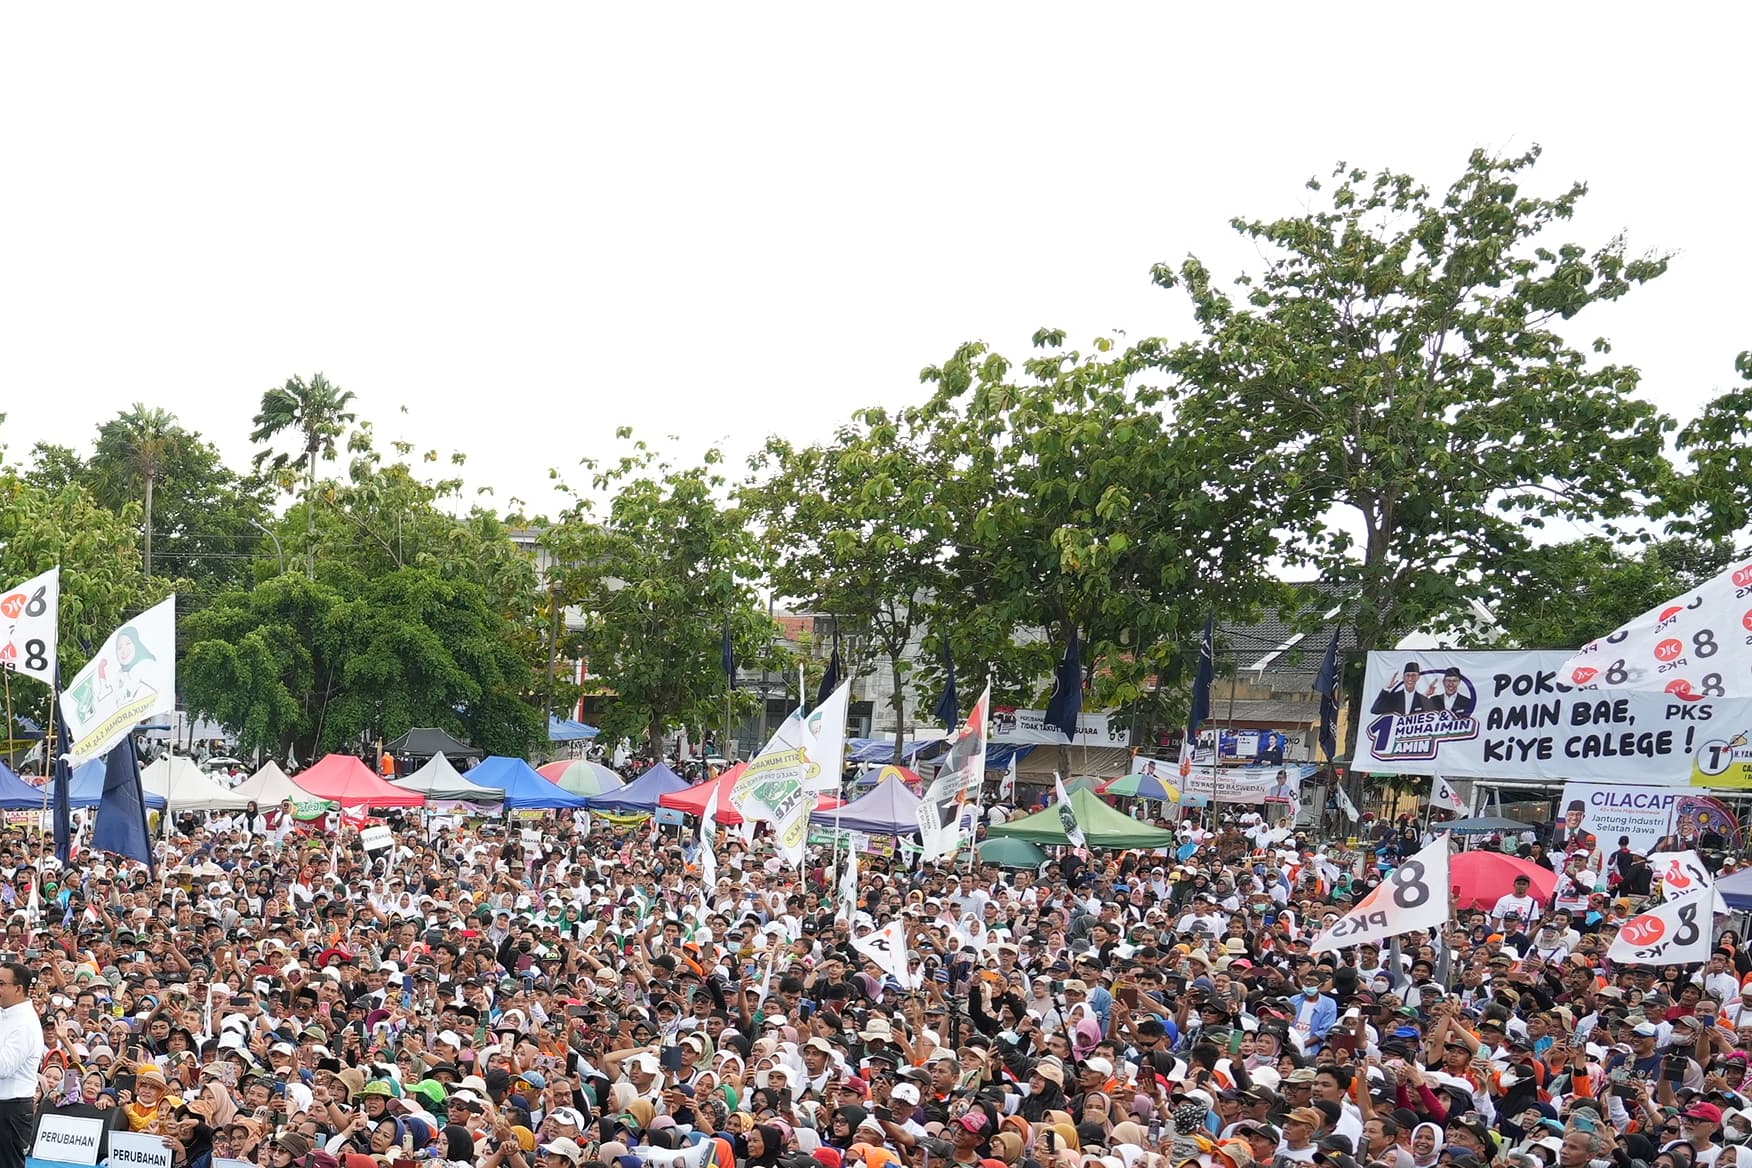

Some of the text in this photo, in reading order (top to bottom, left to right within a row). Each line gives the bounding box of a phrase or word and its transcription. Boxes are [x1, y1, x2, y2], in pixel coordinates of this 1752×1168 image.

[25, 639, 48, 671] 8
[1398, 711, 1448, 725] ANIES &
[1487, 699, 1635, 730] AMIN BAE,
[1665, 704, 1712, 720] PKS
[1370, 715, 1394, 750] 1
[1396, 719, 1470, 735] MUHAIMIN
[1395, 741, 1430, 753] AMIN
[1565, 730, 1672, 758] CALEGE
[1684, 726, 1695, 754] !
[1289, 789, 1298, 801] 8
[1591, 791, 1674, 809] CILACAP
[1592, 814, 1664, 826] Jantung Industri
[1596, 824, 1655, 834] Selatan Jawa
[40, 1131, 95, 1148] PERUBAHAN
[113, 1149, 166, 1167] PERUBAHAN
